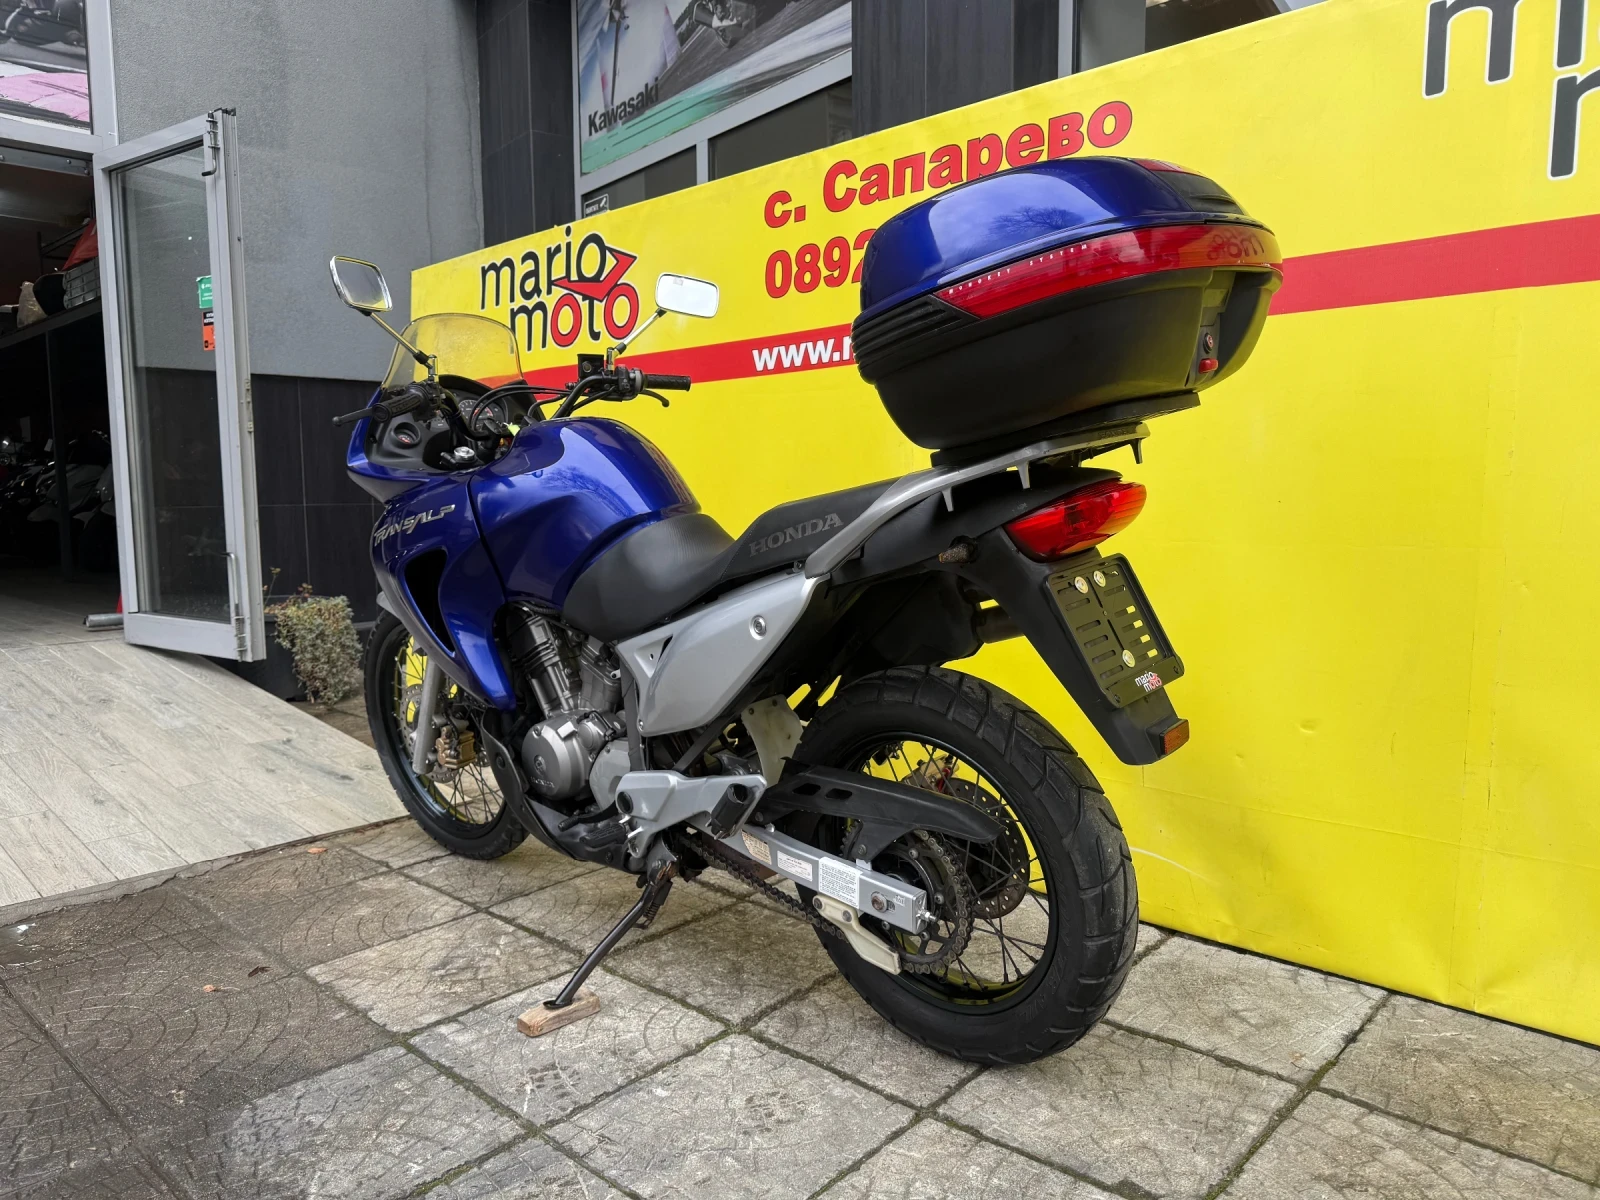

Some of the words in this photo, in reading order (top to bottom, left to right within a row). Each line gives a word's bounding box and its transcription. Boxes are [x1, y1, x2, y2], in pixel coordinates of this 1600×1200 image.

[588, 76, 659, 137] Kawasaki
[764, 190, 806, 228] с.
[822, 100, 1133, 213] Сапарево
[480, 225, 607, 310] mario
[509, 282, 640, 353] moto
[373, 504, 456, 547] TRANSALP
[749, 512, 844, 557] HONDA
